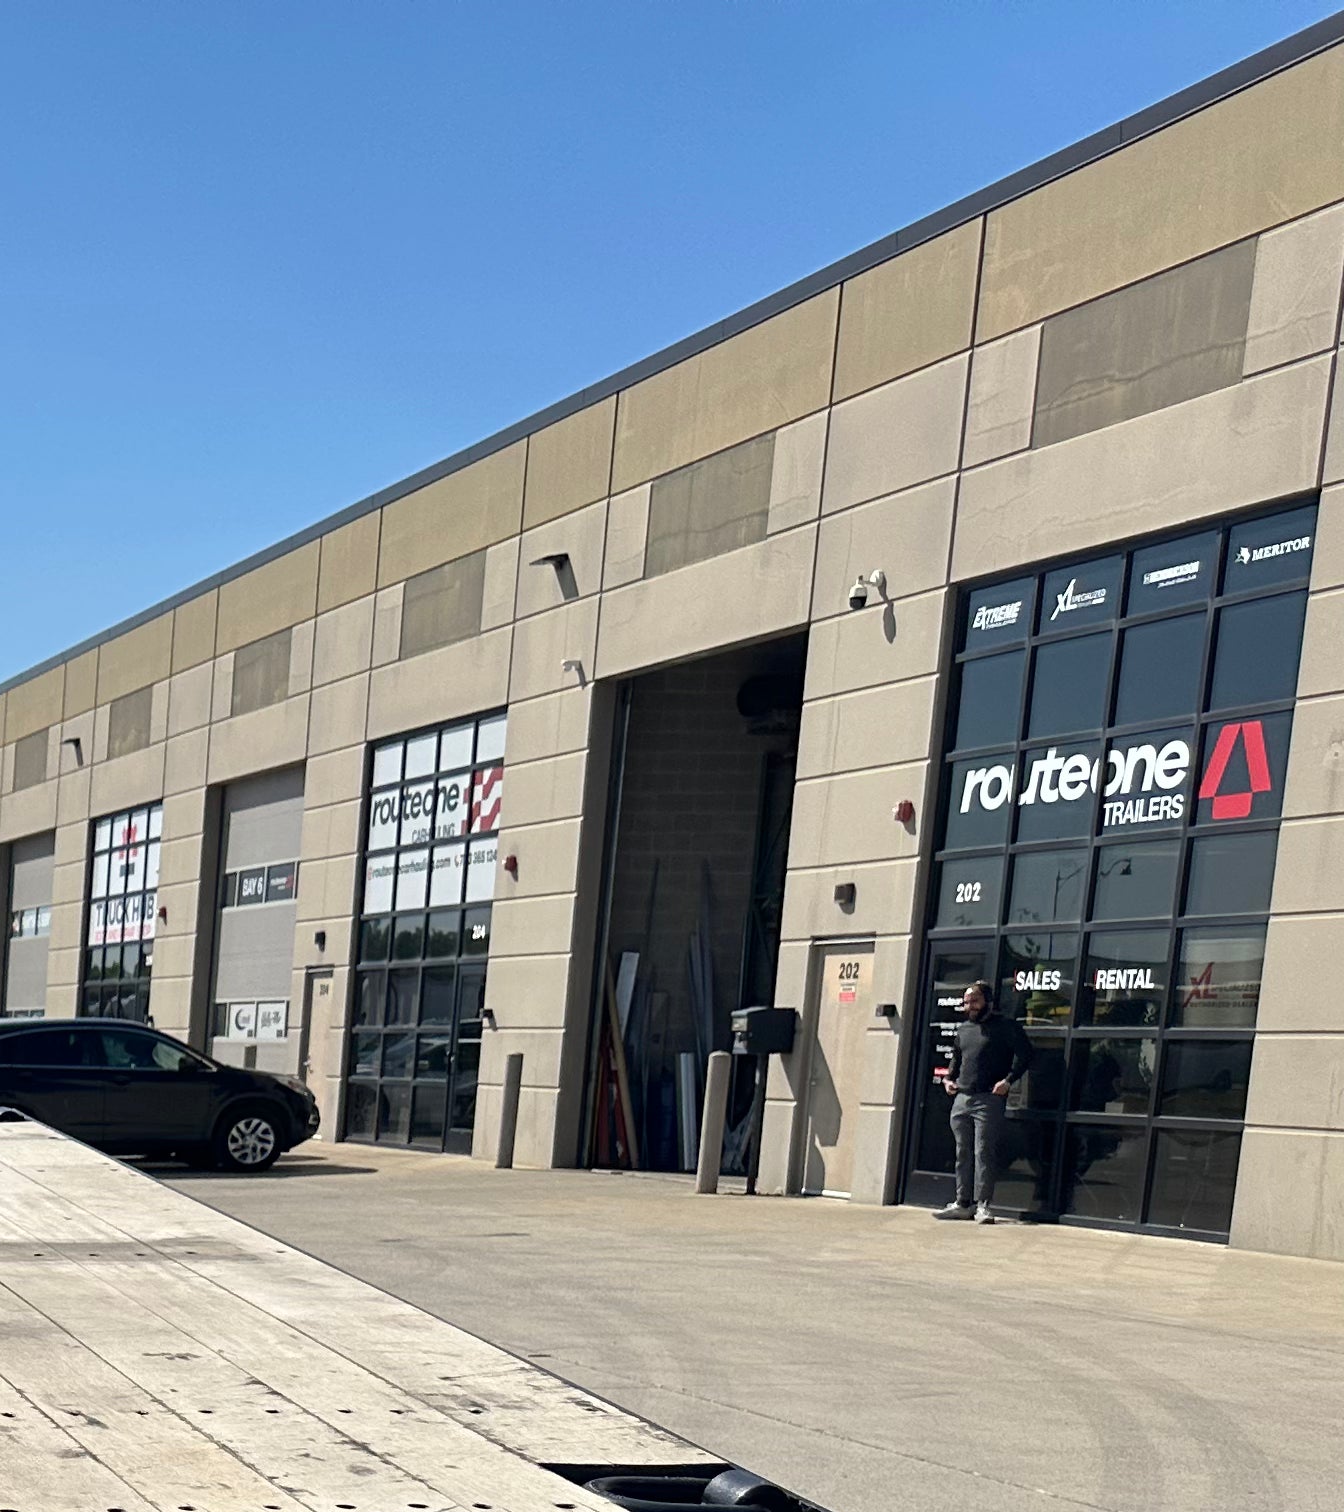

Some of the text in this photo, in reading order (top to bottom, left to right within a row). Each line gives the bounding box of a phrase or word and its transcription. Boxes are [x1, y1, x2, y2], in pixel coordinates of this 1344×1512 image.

[1251, 536, 1310, 562] MERITOR
[972, 600, 1022, 631] EXTREME
[959, 739, 1190, 814] routeone
[1103, 794, 1185, 827] TRAILERS
[955, 882, 982, 903] 202
[838, 962, 860, 980] 202
[1015, 970, 1062, 991] SALES
[1095, 968, 1155, 990] RENTAL
